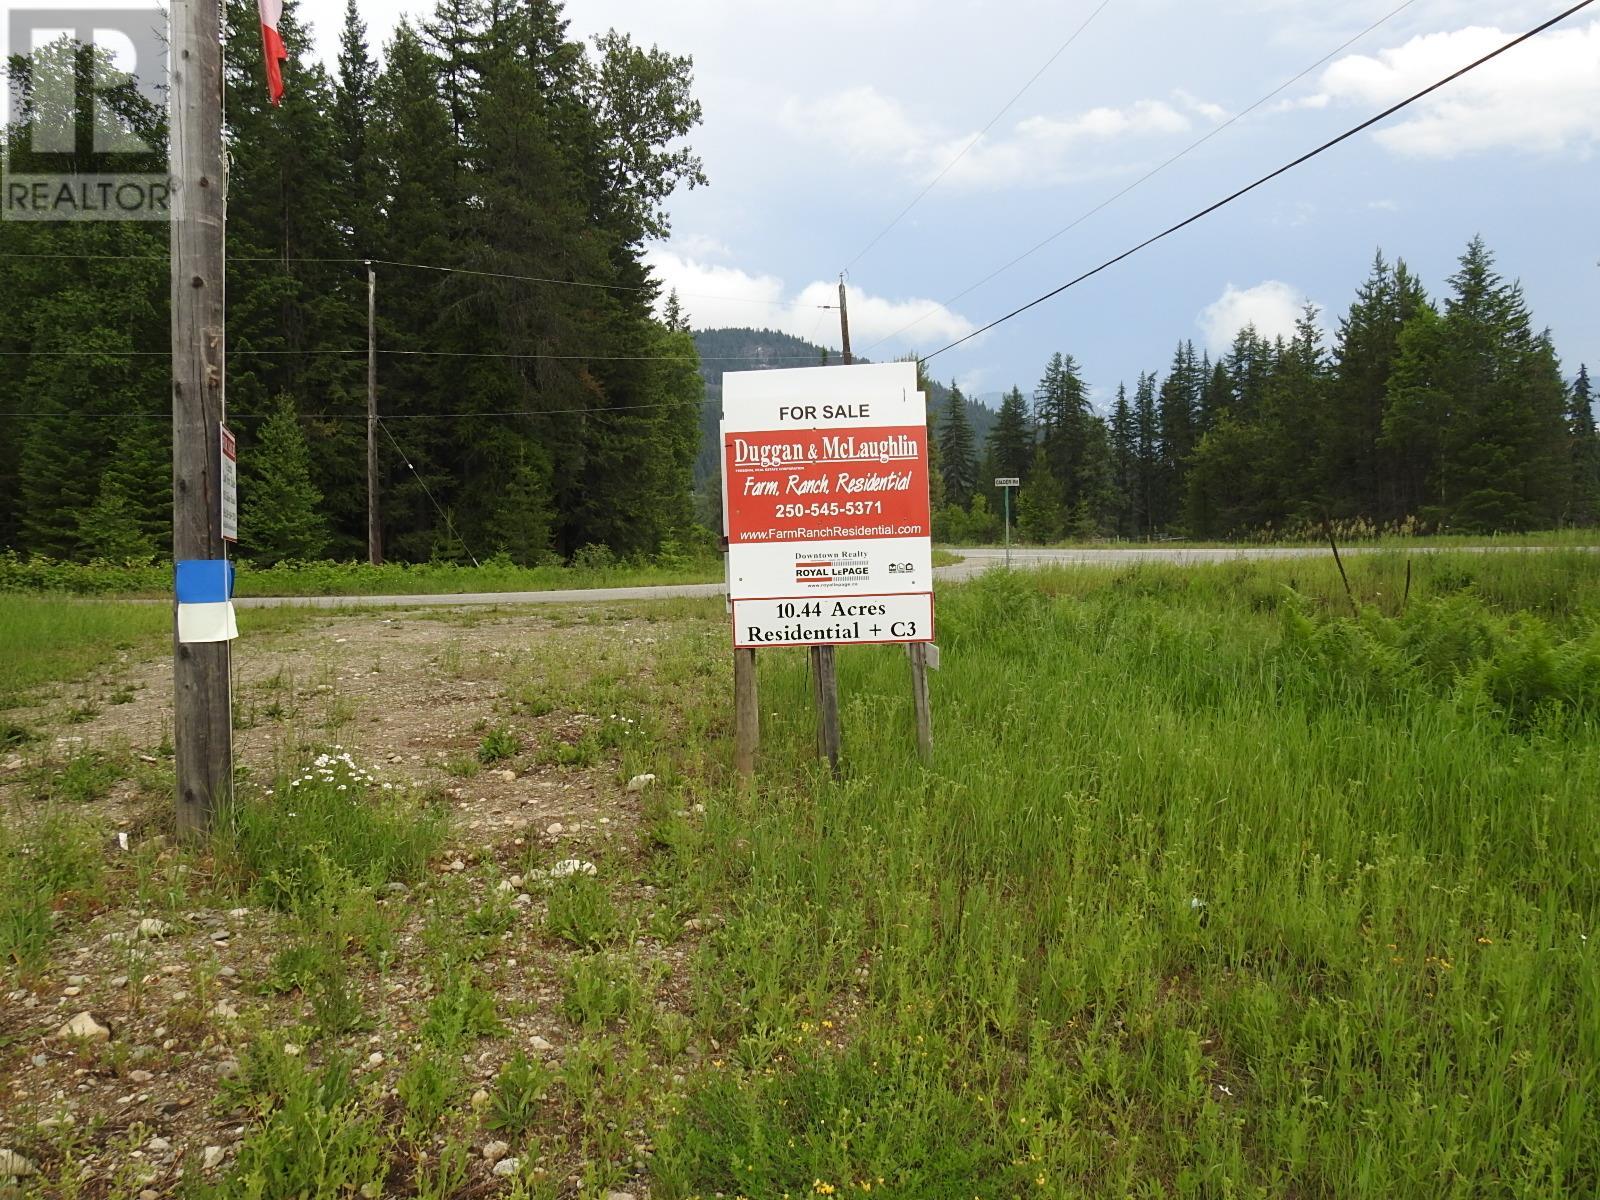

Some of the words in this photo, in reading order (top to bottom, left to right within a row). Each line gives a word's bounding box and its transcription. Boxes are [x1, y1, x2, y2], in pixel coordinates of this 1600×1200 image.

[779, 406, 817, 421] FOR
[822, 404, 870, 418] SALE
[734, 438, 804, 467] Duggan
[807, 444, 818, 460] &
[822, 435, 918, 464] McLaughlin
[743, 476, 780, 496] Farm,
[785, 474, 830, 495] Ranch,
[835, 471, 912, 492] Residential
[775, 501, 882, 518] 250-545-5371
[740, 525, 921, 540] www.FarmRanchResidential.com
[795, 552, 839, 560] Downtown
[841, 550, 868, 558] Realty
[796, 569, 829, 577] ROYAL
[776, 601, 822, 618] 10.44
[832, 601, 886, 616] Acres
[748, 622, 860, 642] Residential
[870, 624, 882, 637] +
[891, 621, 917, 637] C3
